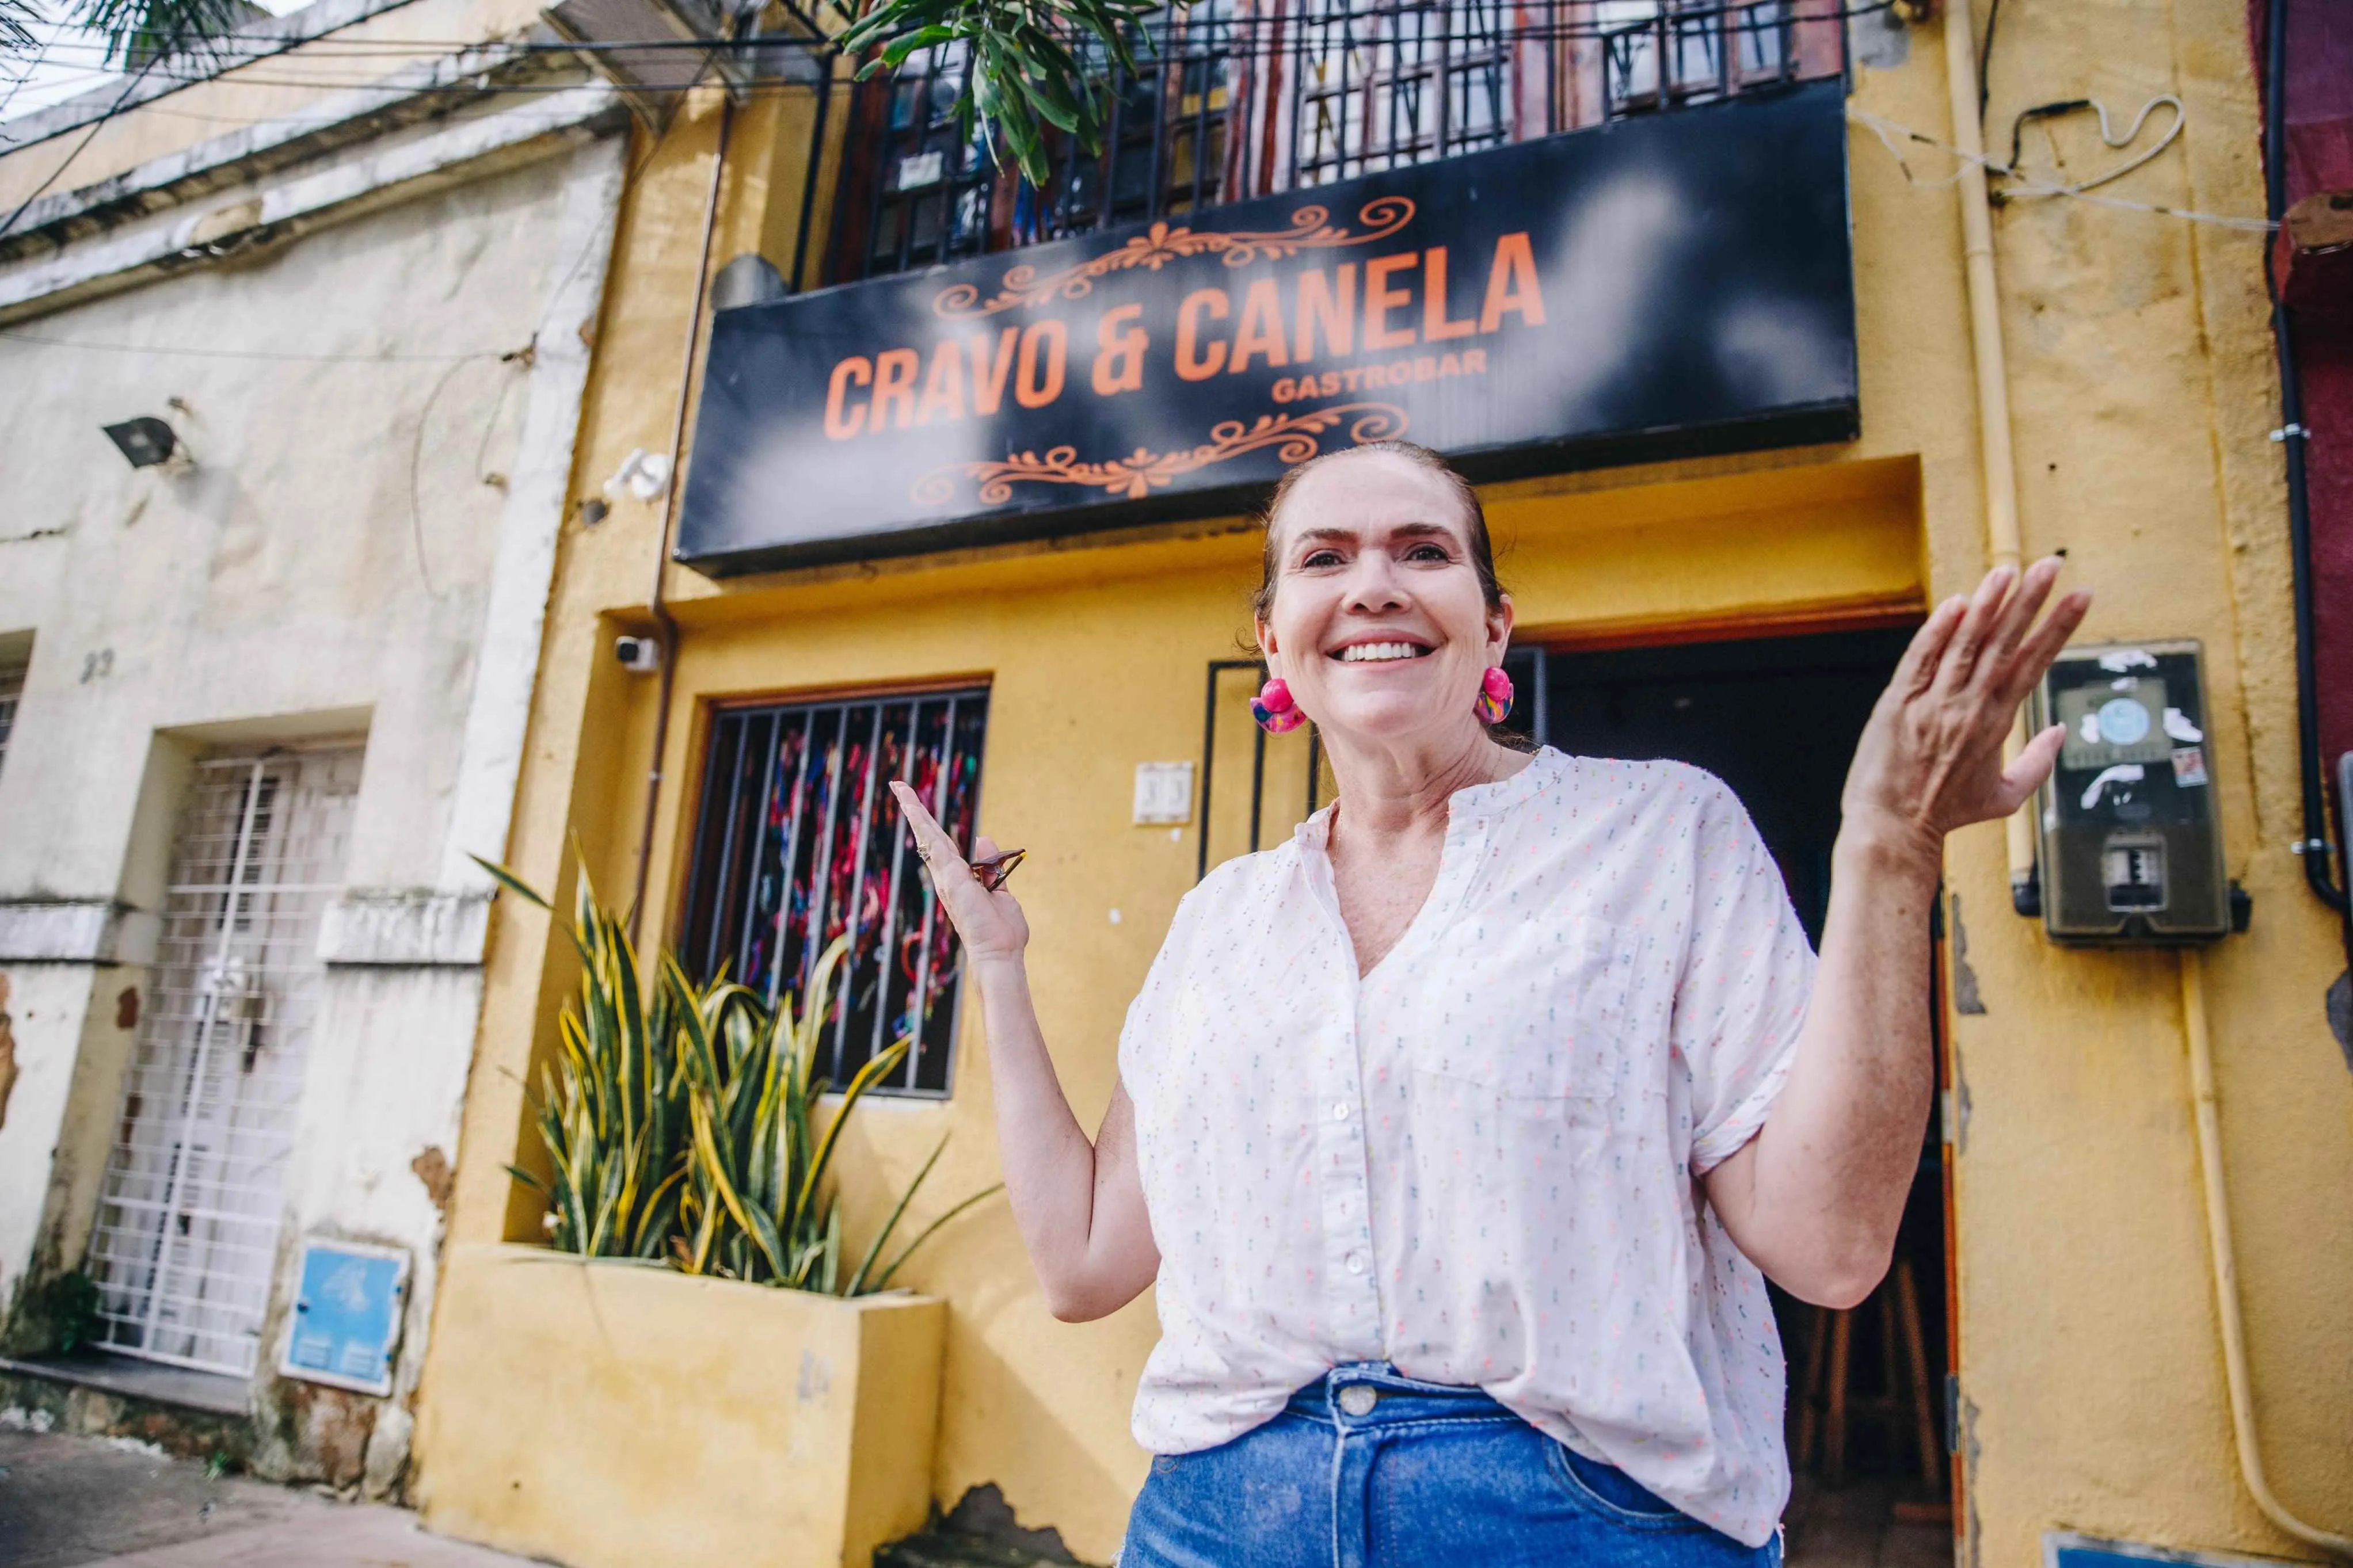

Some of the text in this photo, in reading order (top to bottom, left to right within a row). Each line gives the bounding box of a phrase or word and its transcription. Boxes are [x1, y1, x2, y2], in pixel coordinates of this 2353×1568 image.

[824, 231, 1547, 441] CRAVO & CANELA
[1271, 348, 1487, 403] GASTROBAR
